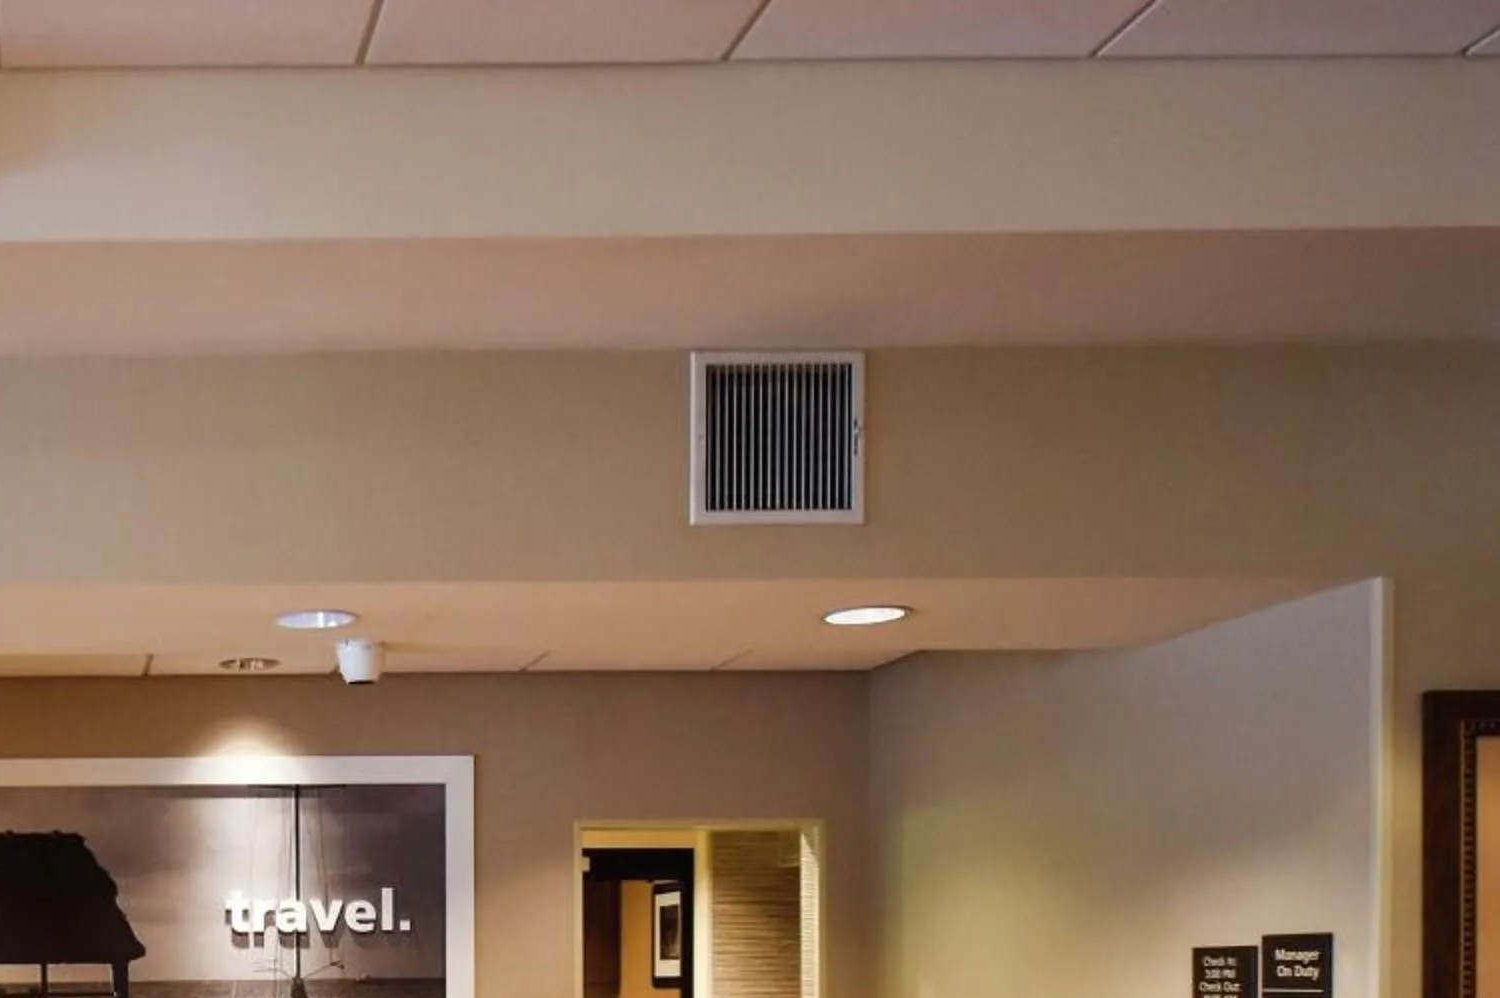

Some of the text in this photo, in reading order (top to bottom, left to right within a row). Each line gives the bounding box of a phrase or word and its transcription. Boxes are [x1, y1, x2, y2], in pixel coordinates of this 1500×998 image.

[224, 887, 411, 934] travel.
[1275, 949, 1321, 964] Manager
[1277, 965, 1320, 981] On Duty
[1199, 981, 1222, 992] Check
